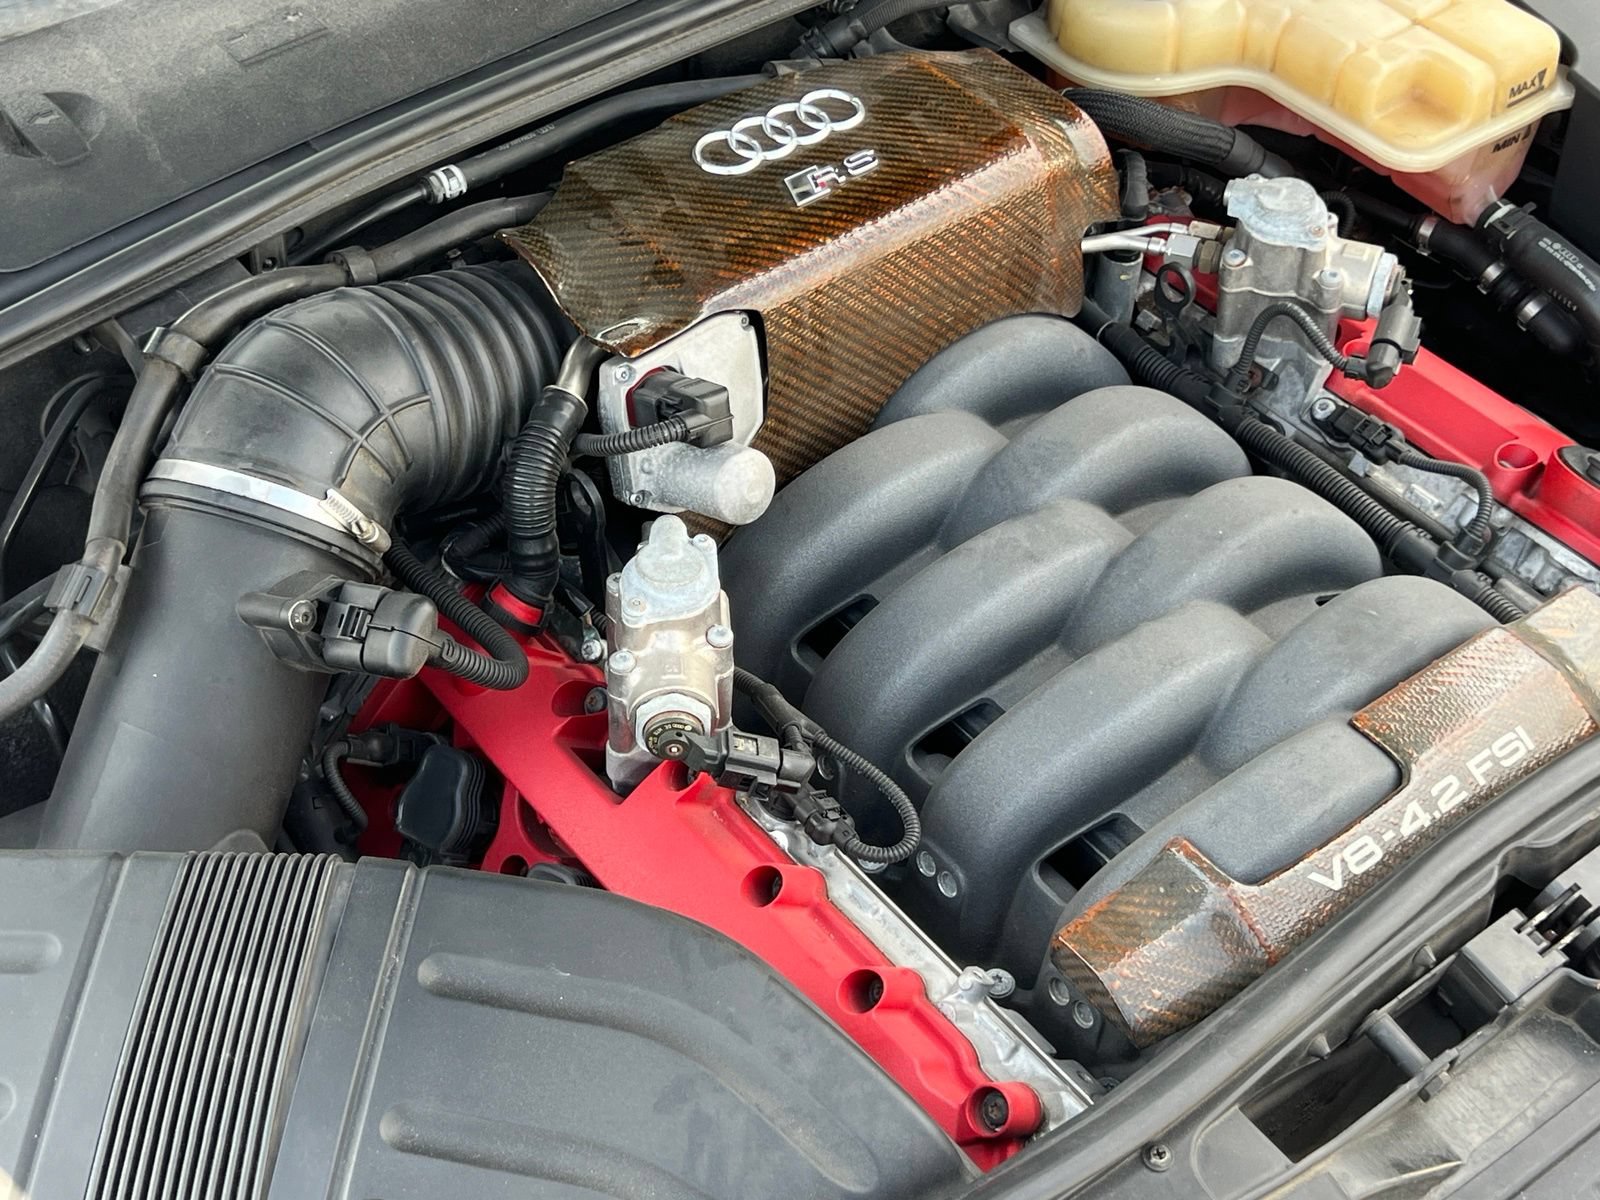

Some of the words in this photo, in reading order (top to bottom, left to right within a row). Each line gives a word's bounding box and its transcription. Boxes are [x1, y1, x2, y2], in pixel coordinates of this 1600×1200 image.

[1508, 75, 1538, 99] MAX
[1491, 133, 1521, 153] MIN
[1465, 725, 1536, 787] FSI
